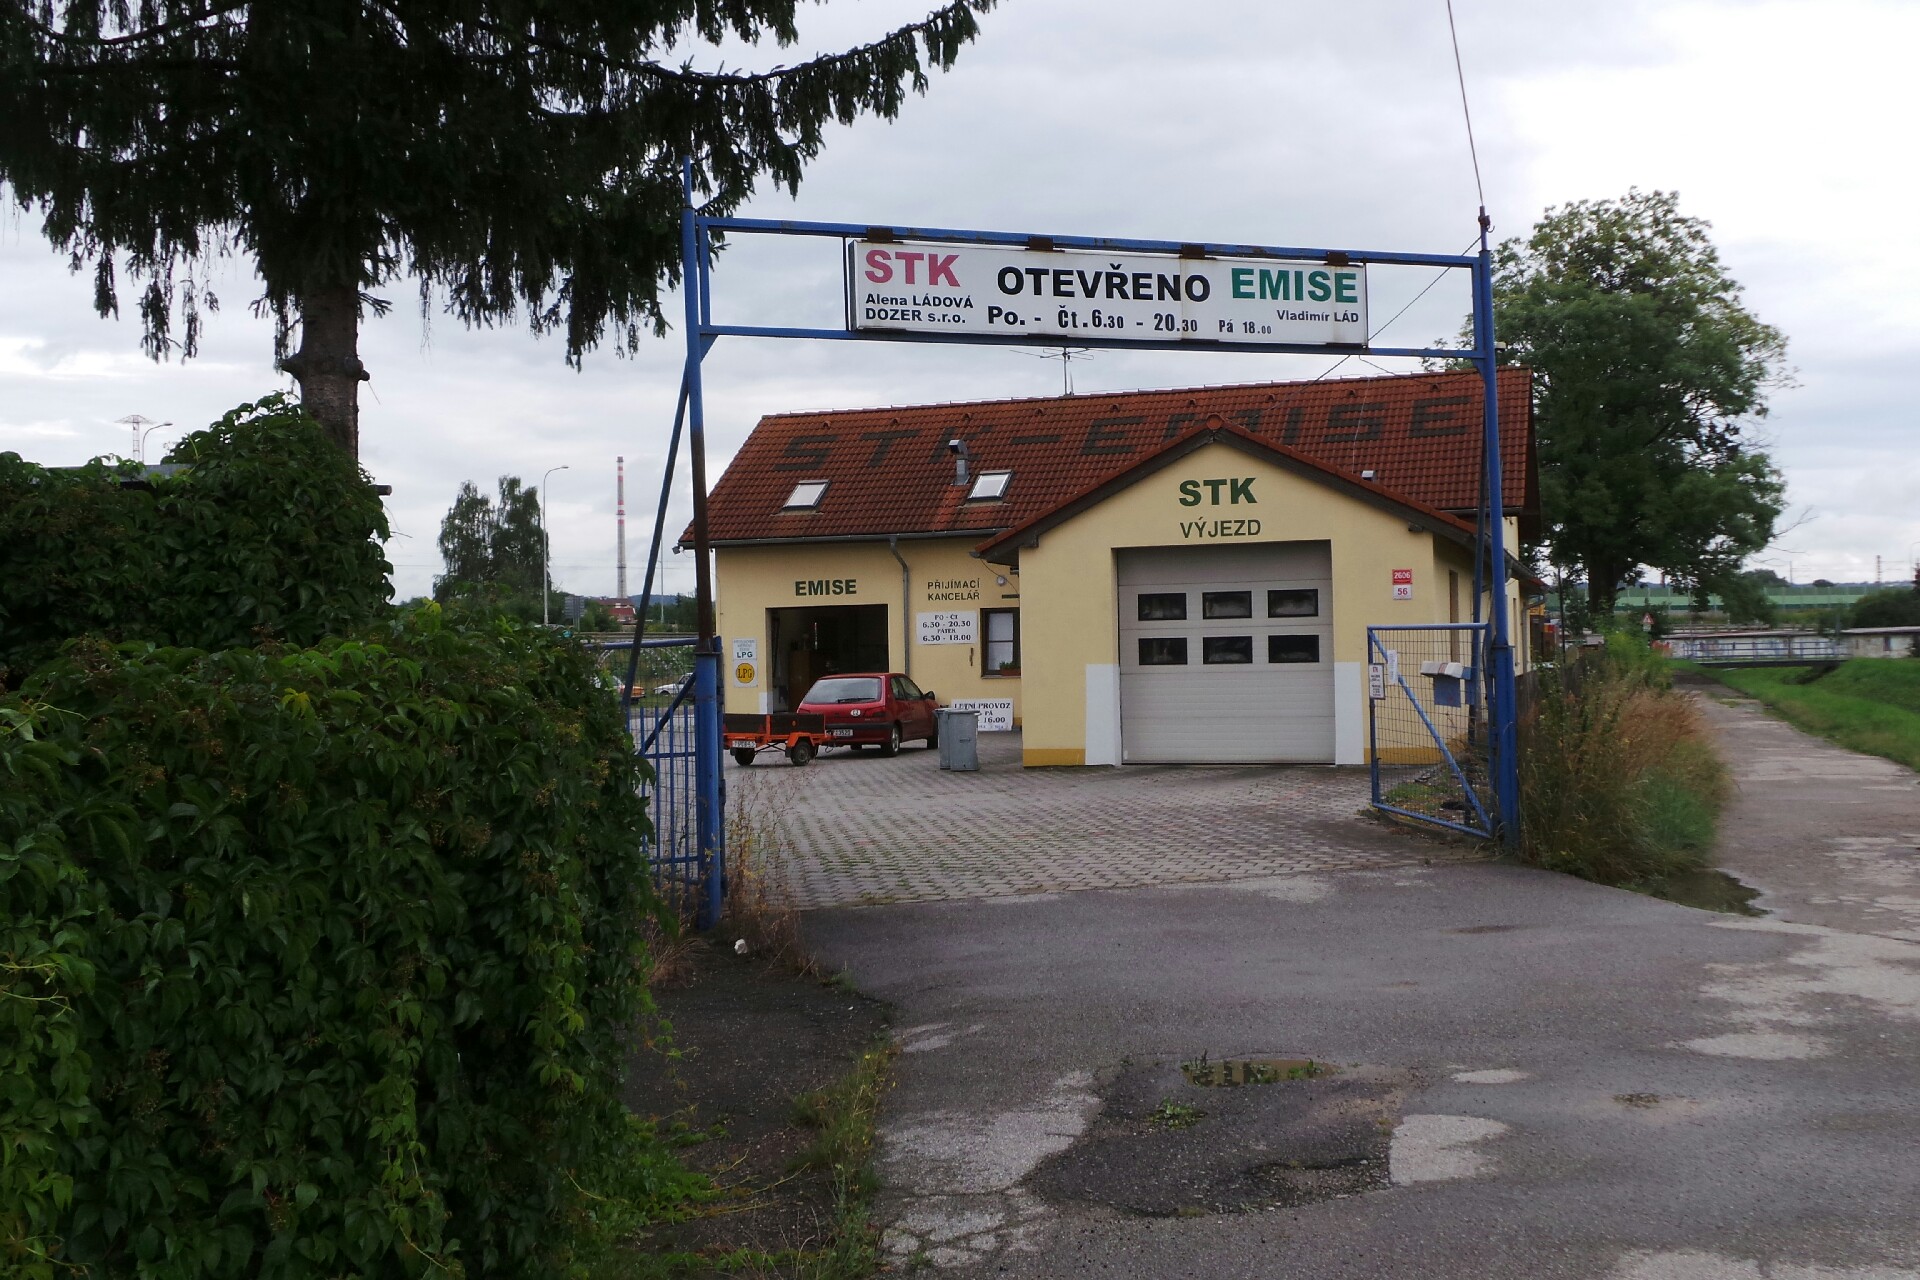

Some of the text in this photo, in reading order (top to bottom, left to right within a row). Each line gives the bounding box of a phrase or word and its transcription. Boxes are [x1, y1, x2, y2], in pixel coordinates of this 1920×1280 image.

[865, 249, 961, 288] STK
[997, 263, 1211, 303] OTEVŘENO
[1231, 267, 1359, 304] EMISE
[865, 292, 974, 309] Alena LÁDOVÁ
[865, 307, 966, 324] DOZER s.r.o.
[987, 305, 1026, 326] Po.
[1153, 313, 1198, 333] 20.30
[1218, 318, 1234, 333] Pá
[1242, 321, 1272, 335] 18.00
[1276, 309, 1359, 323] Vladimír LÁD
[772, 424, 994, 471] STK
[1178, 477, 1258, 507] STK
[1179, 516, 1262, 539] VÝJEZD
[795, 579, 857, 596] EMISE
[927, 577, 980, 590] PŘIJÍMACÍ
[1397, 587, 1408, 596] 56
[927, 589, 980, 601] KANCELÁŘ
[922, 621, 940, 629] 6.30
[947, 620, 971, 628] 20.30
[922, 634, 941, 642] 6.30
[736, 651, 753, 659] LPG
[737, 668, 753, 679] LPG
